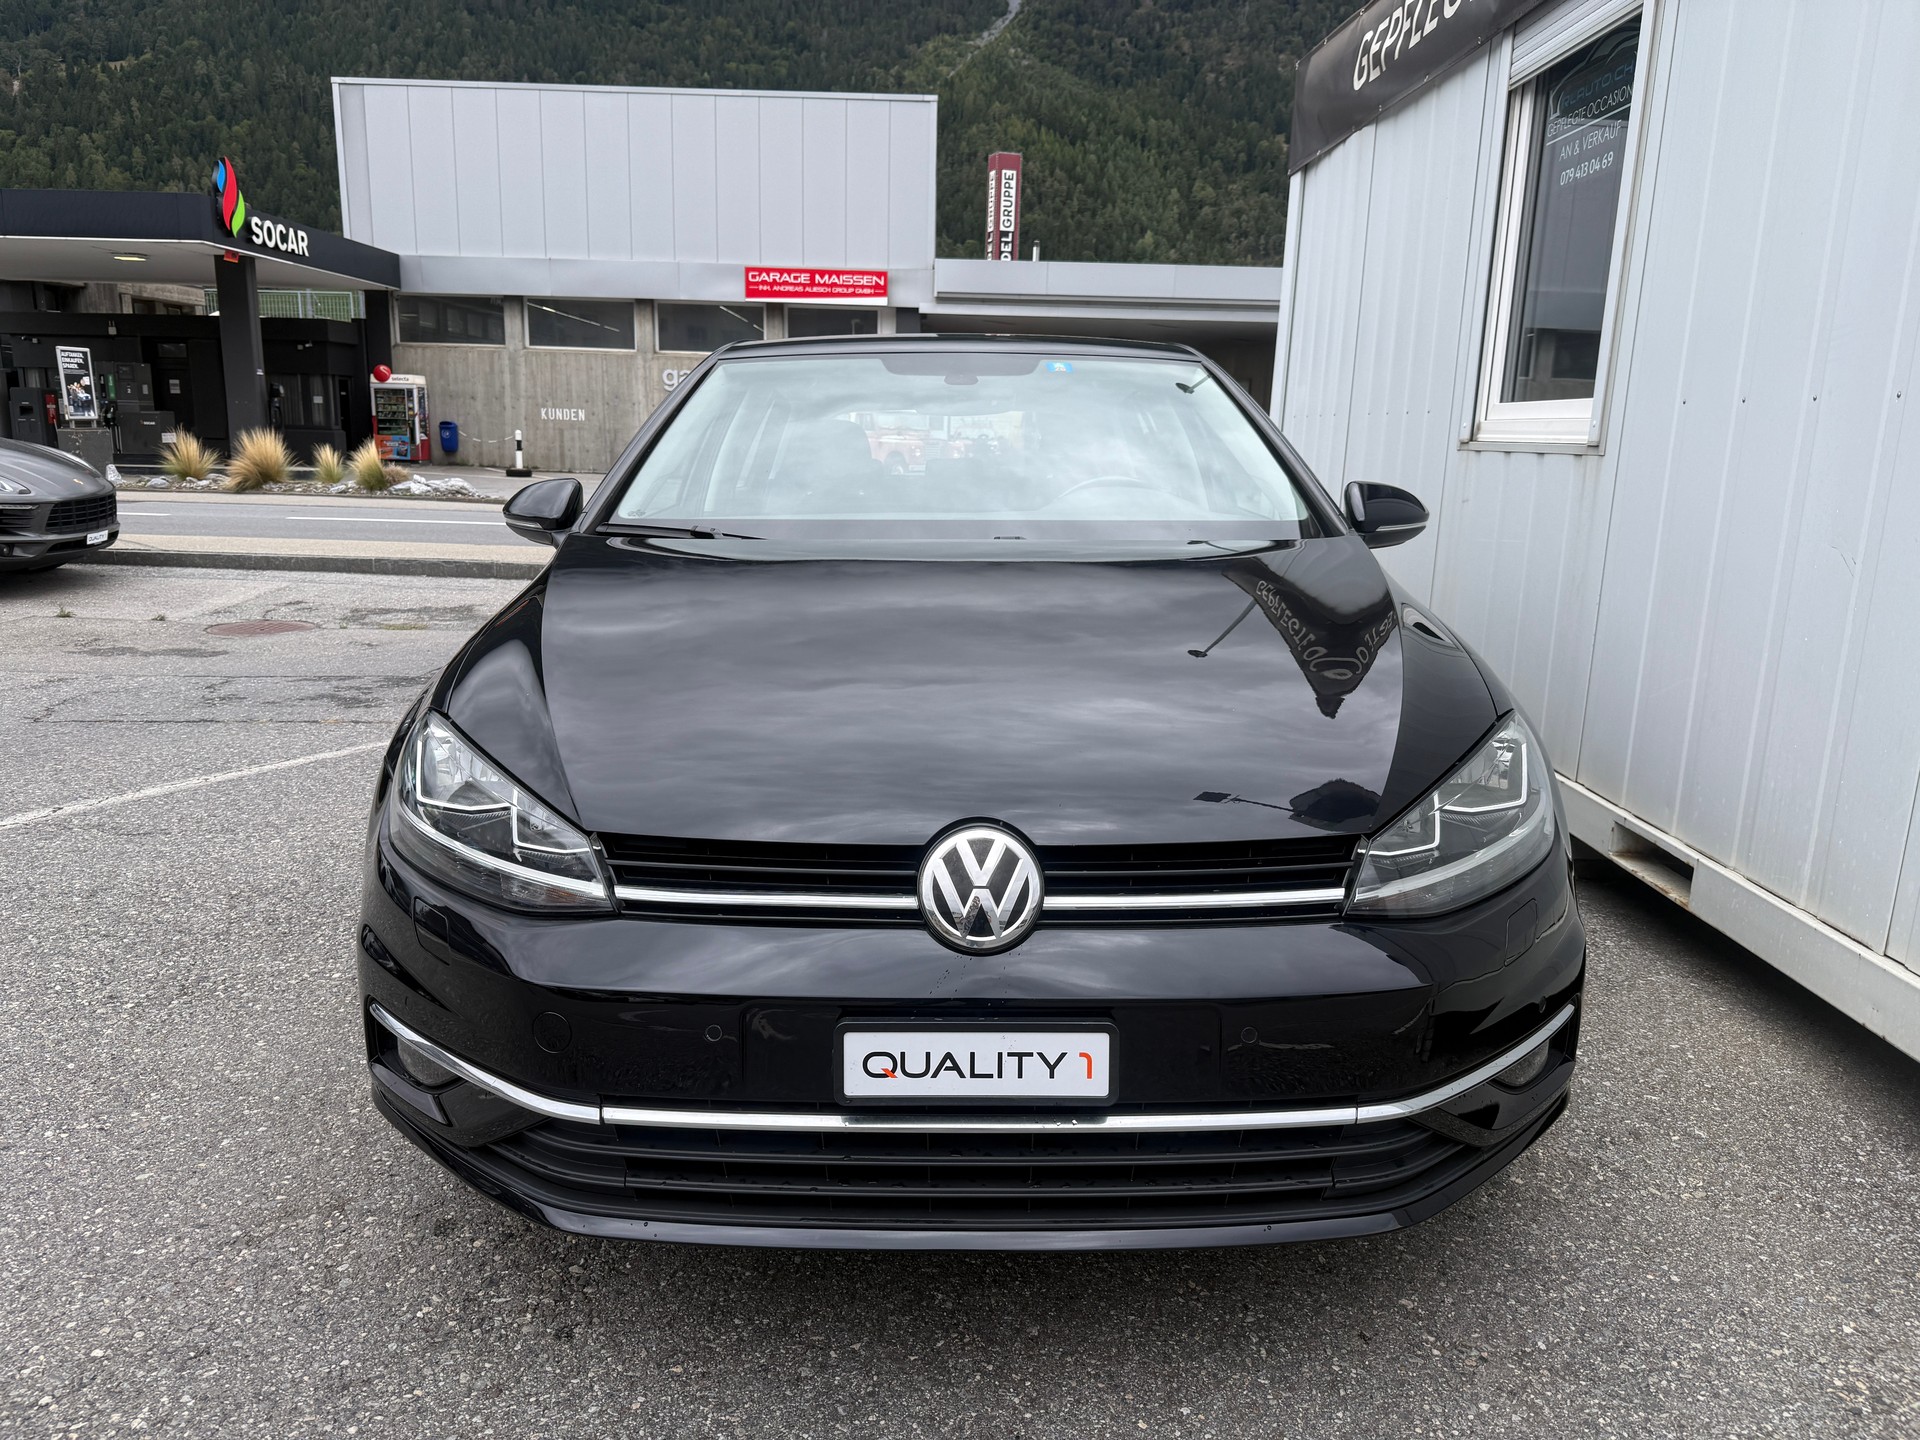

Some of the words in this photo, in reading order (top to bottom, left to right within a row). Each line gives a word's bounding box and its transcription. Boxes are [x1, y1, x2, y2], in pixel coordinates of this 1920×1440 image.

[1353, 0, 1473, 91] GEPFLE
[1547, 106, 1586, 137] GEPFLEGTE
[1559, 142, 1573, 162] AN
[1573, 140, 1580, 156] &
[1582, 119, 1622, 151] VERKAUF
[1560, 167, 1575, 186] 079
[1575, 161, 1589, 179] 413
[1589, 156, 1601, 174] 04
[1601, 151, 1614, 169] 69
[1002, 172, 1015, 229] GRUPPE
[250, 216, 310, 257] SOCAR
[748, 271, 811, 284] GARAGE
[815, 273, 885, 287] MAISSEN
[772, 285, 803, 293] ANDREAS
[541, 407, 585, 421] KUNDEN
[862, 1051, 1068, 1079] QUALITY
[1078, 1052, 1093, 1080] 1
